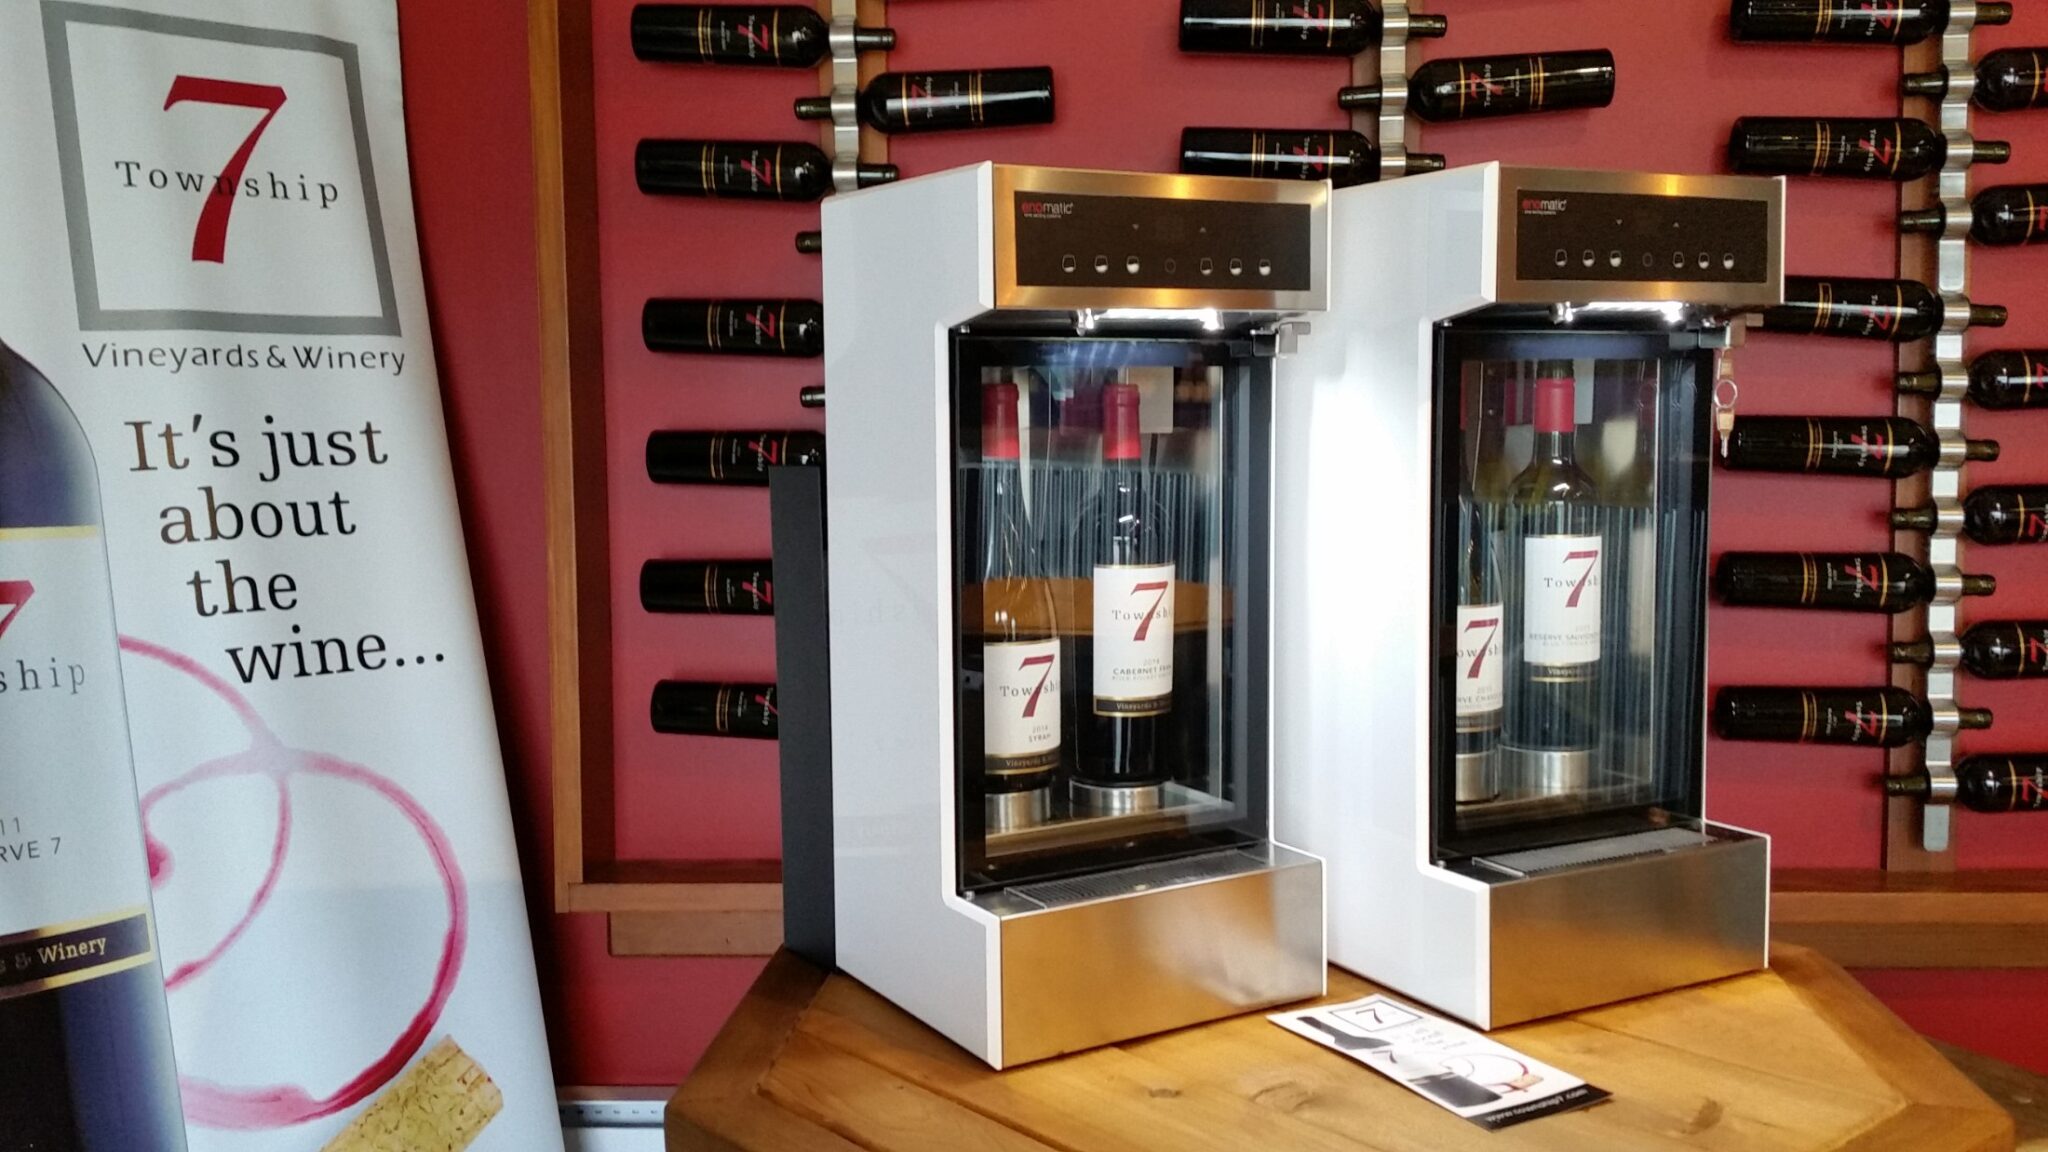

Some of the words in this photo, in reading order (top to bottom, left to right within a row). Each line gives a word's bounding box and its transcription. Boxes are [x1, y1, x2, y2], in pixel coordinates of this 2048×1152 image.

[737, 24, 769, 51] 7
[1471, 72, 1504, 98] 7
[1858, 137, 1892, 166] 7
[115, 160, 340, 209] Township
[163, 74, 288, 264] 7
[740, 159, 771, 186] 7
[746, 312, 775, 338] 7
[82, 342, 260, 374] Vineyards
[266, 345, 287, 368] &
[293, 345, 405, 376] Winery
[124, 414, 240, 472] It's
[259, 415, 388, 482] just
[748, 439, 778, 465] 7
[160, 486, 356, 544] about
[187, 559, 298, 616] the
[742, 580, 772, 605] 7
[1563, 550, 1598, 608] 7
[1844, 563, 1878, 591] 7
[1131, 580, 1169, 641] 7
[226, 624, 445, 684] wine...
[1464, 617, 1498, 679] 7
[1019, 653, 1055, 718] 7
[1844, 710, 1878, 737] 7
[51, 837, 61, 855] 7
[38, 937, 106, 965] Winery
